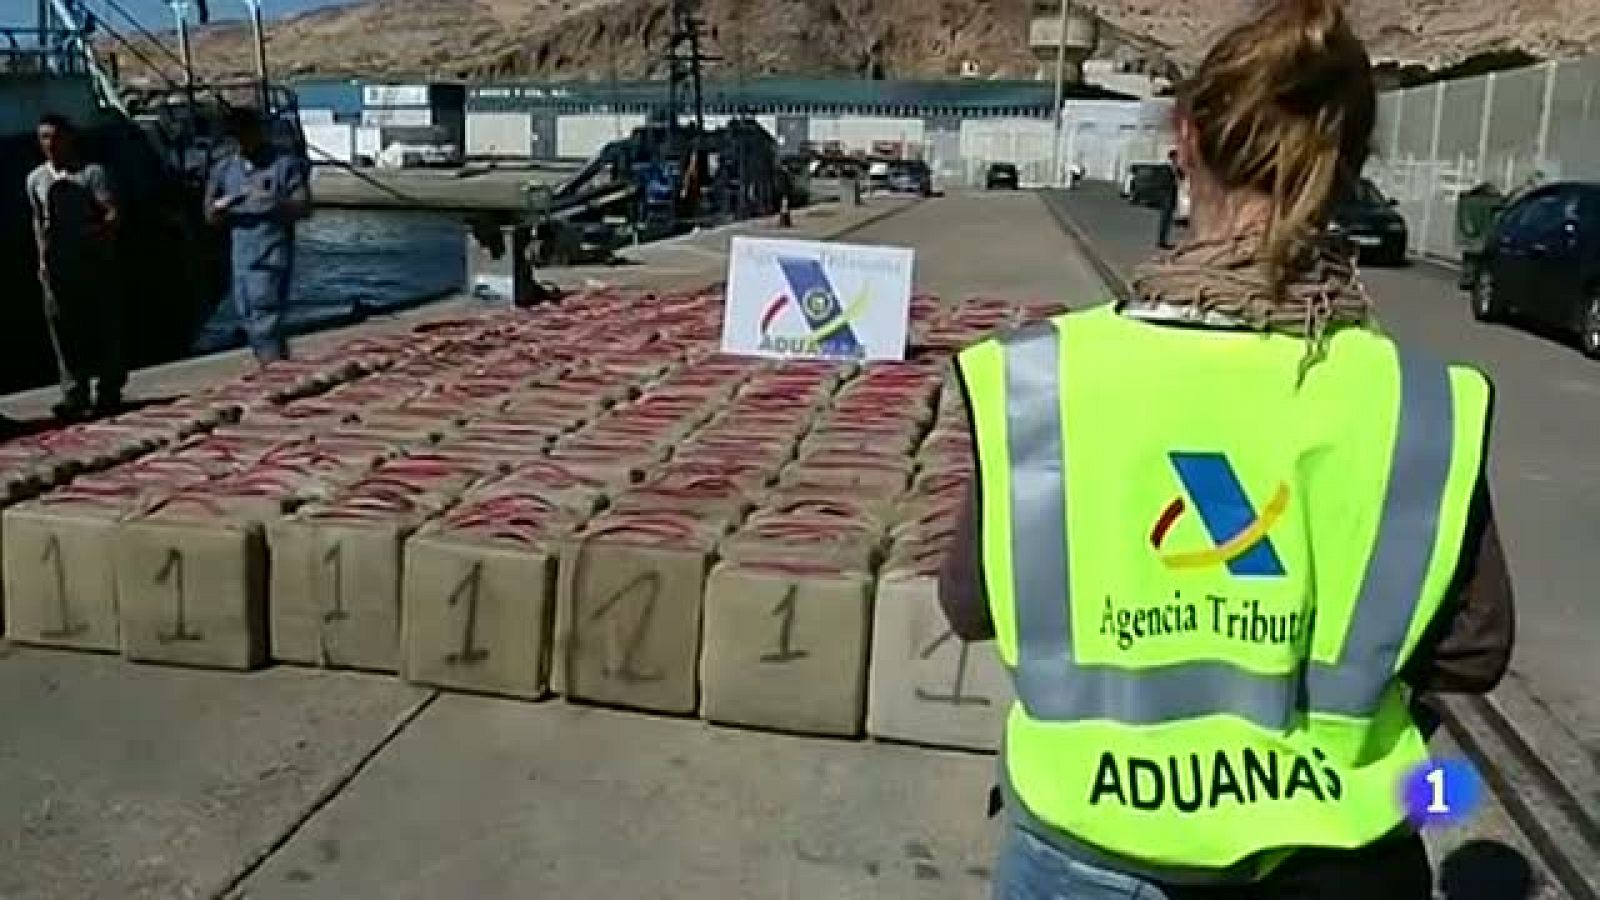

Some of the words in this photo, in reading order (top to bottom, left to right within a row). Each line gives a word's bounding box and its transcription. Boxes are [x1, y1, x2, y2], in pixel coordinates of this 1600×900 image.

[758, 335, 867, 358] ADUA
[40, 536, 90, 639] 1
[155, 548, 205, 643] 1
[324, 541, 349, 623] 1
[447, 560, 491, 667] 1
[1099, 591, 1197, 650] Agencia
[760, 584, 811, 664] 1
[1089, 747, 1342, 813] ADUANAS
